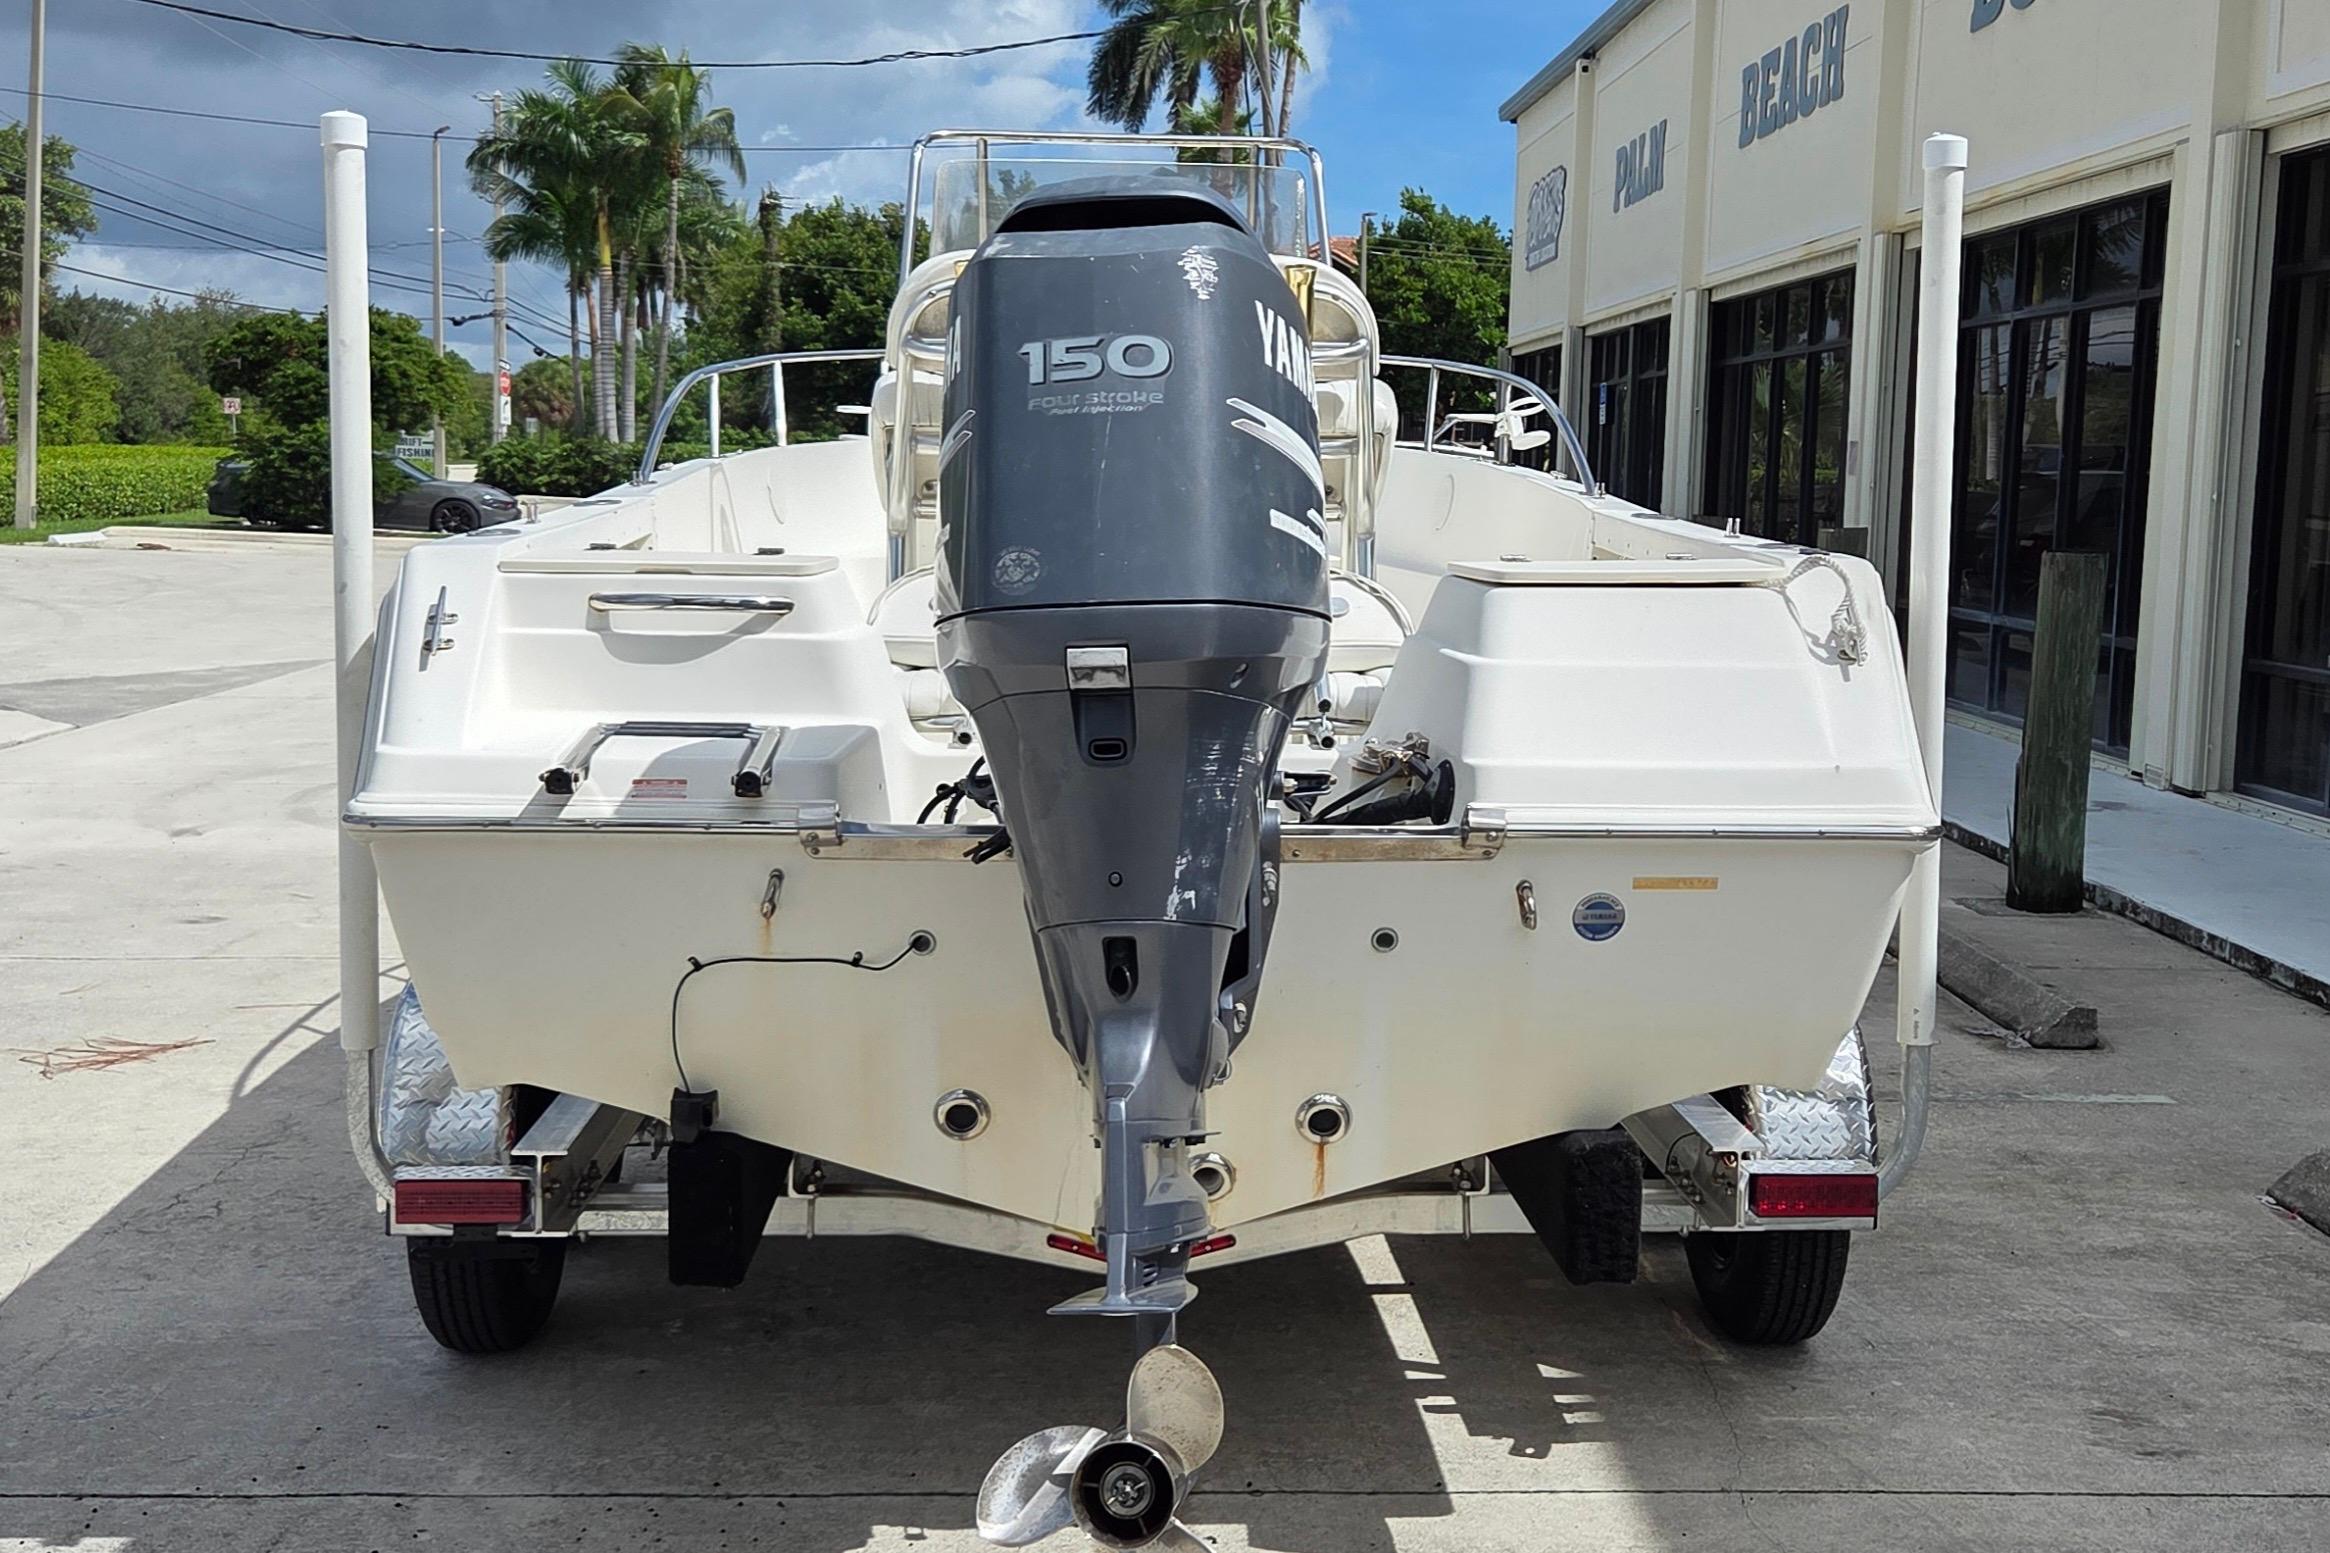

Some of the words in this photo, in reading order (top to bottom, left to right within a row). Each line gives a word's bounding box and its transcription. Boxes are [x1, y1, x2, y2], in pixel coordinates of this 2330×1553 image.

[1613, 118, 1667, 214] PALM
[1739, 3, 1849, 149] BEACH
[1018, 335, 1173, 385] 150
[397, 447, 434, 458] FISHIN
